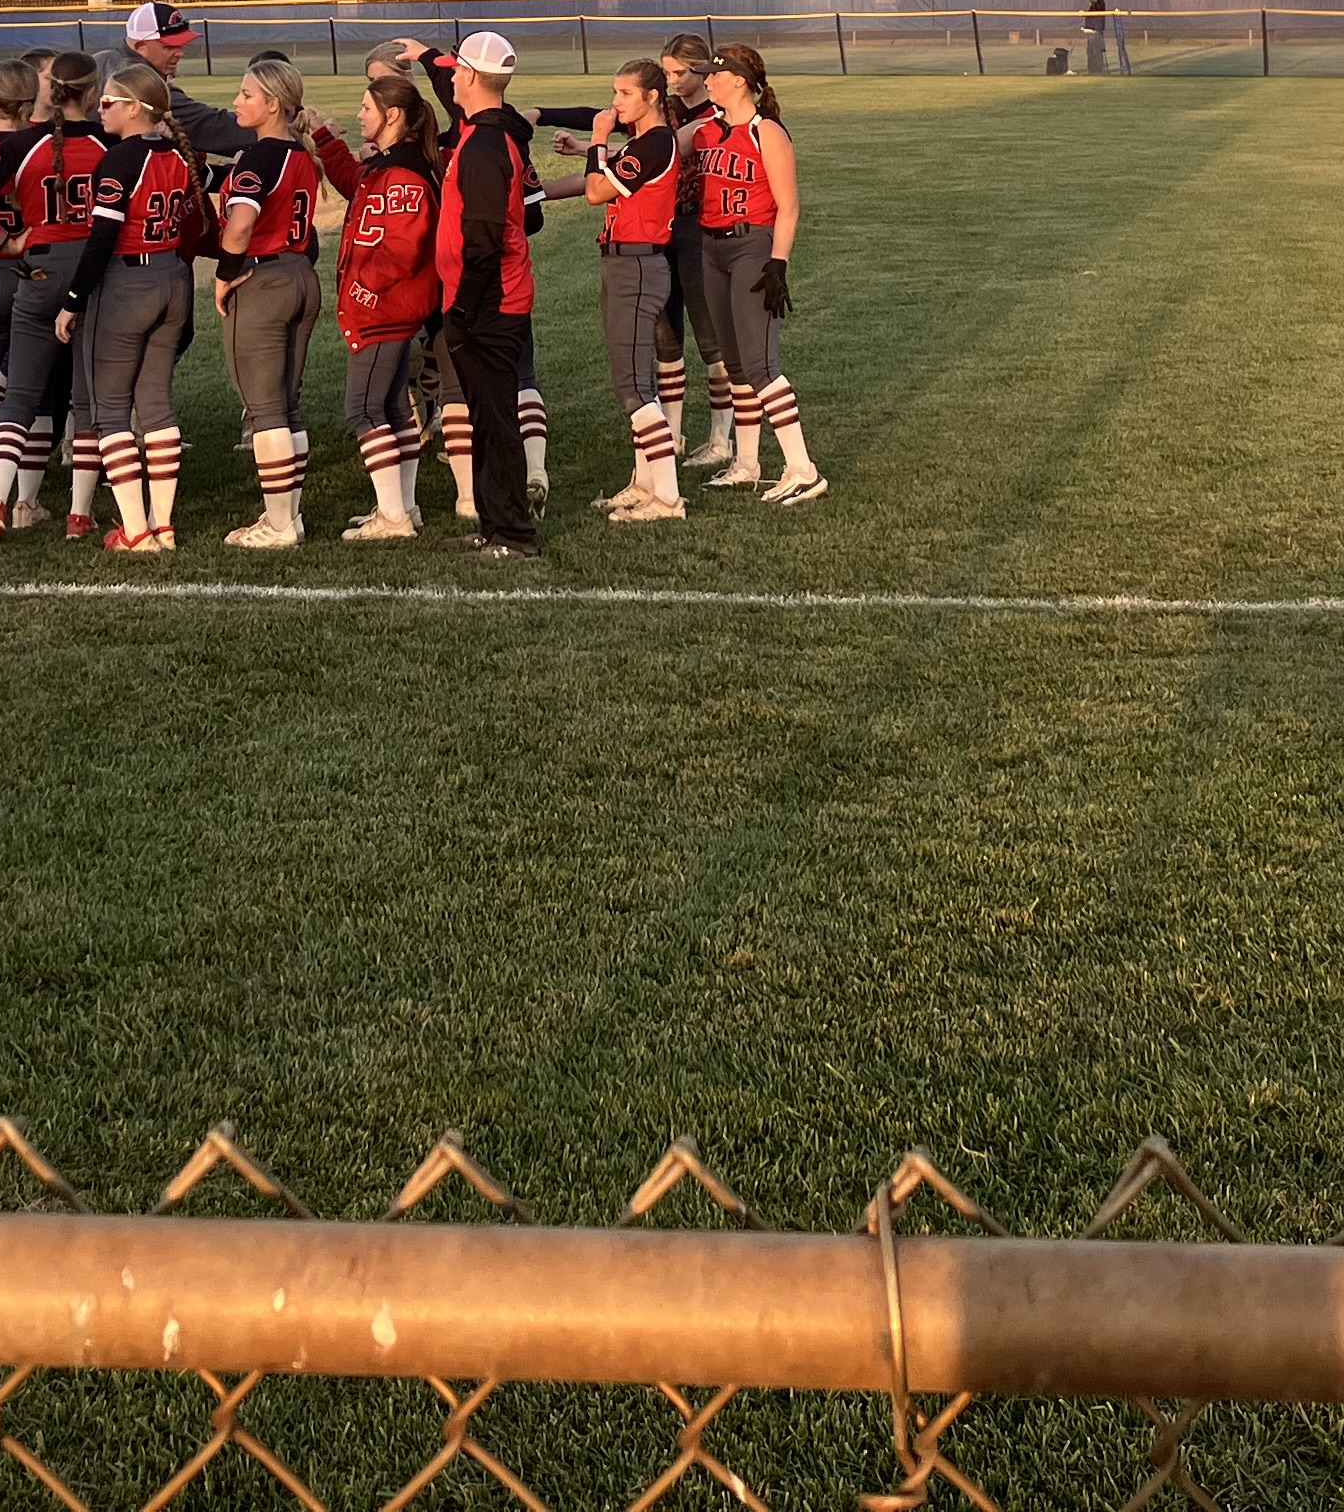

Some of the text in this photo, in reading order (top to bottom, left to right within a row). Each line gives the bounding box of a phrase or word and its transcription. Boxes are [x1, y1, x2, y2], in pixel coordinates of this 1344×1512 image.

[696, 147, 757, 183] HILLI
[41, 174, 93, 225] 19
[386, 185, 424, 214] 27
[720, 187, 749, 216] 12
[287, 189, 311, 245] 3
[348, 280, 378, 310] FFA
